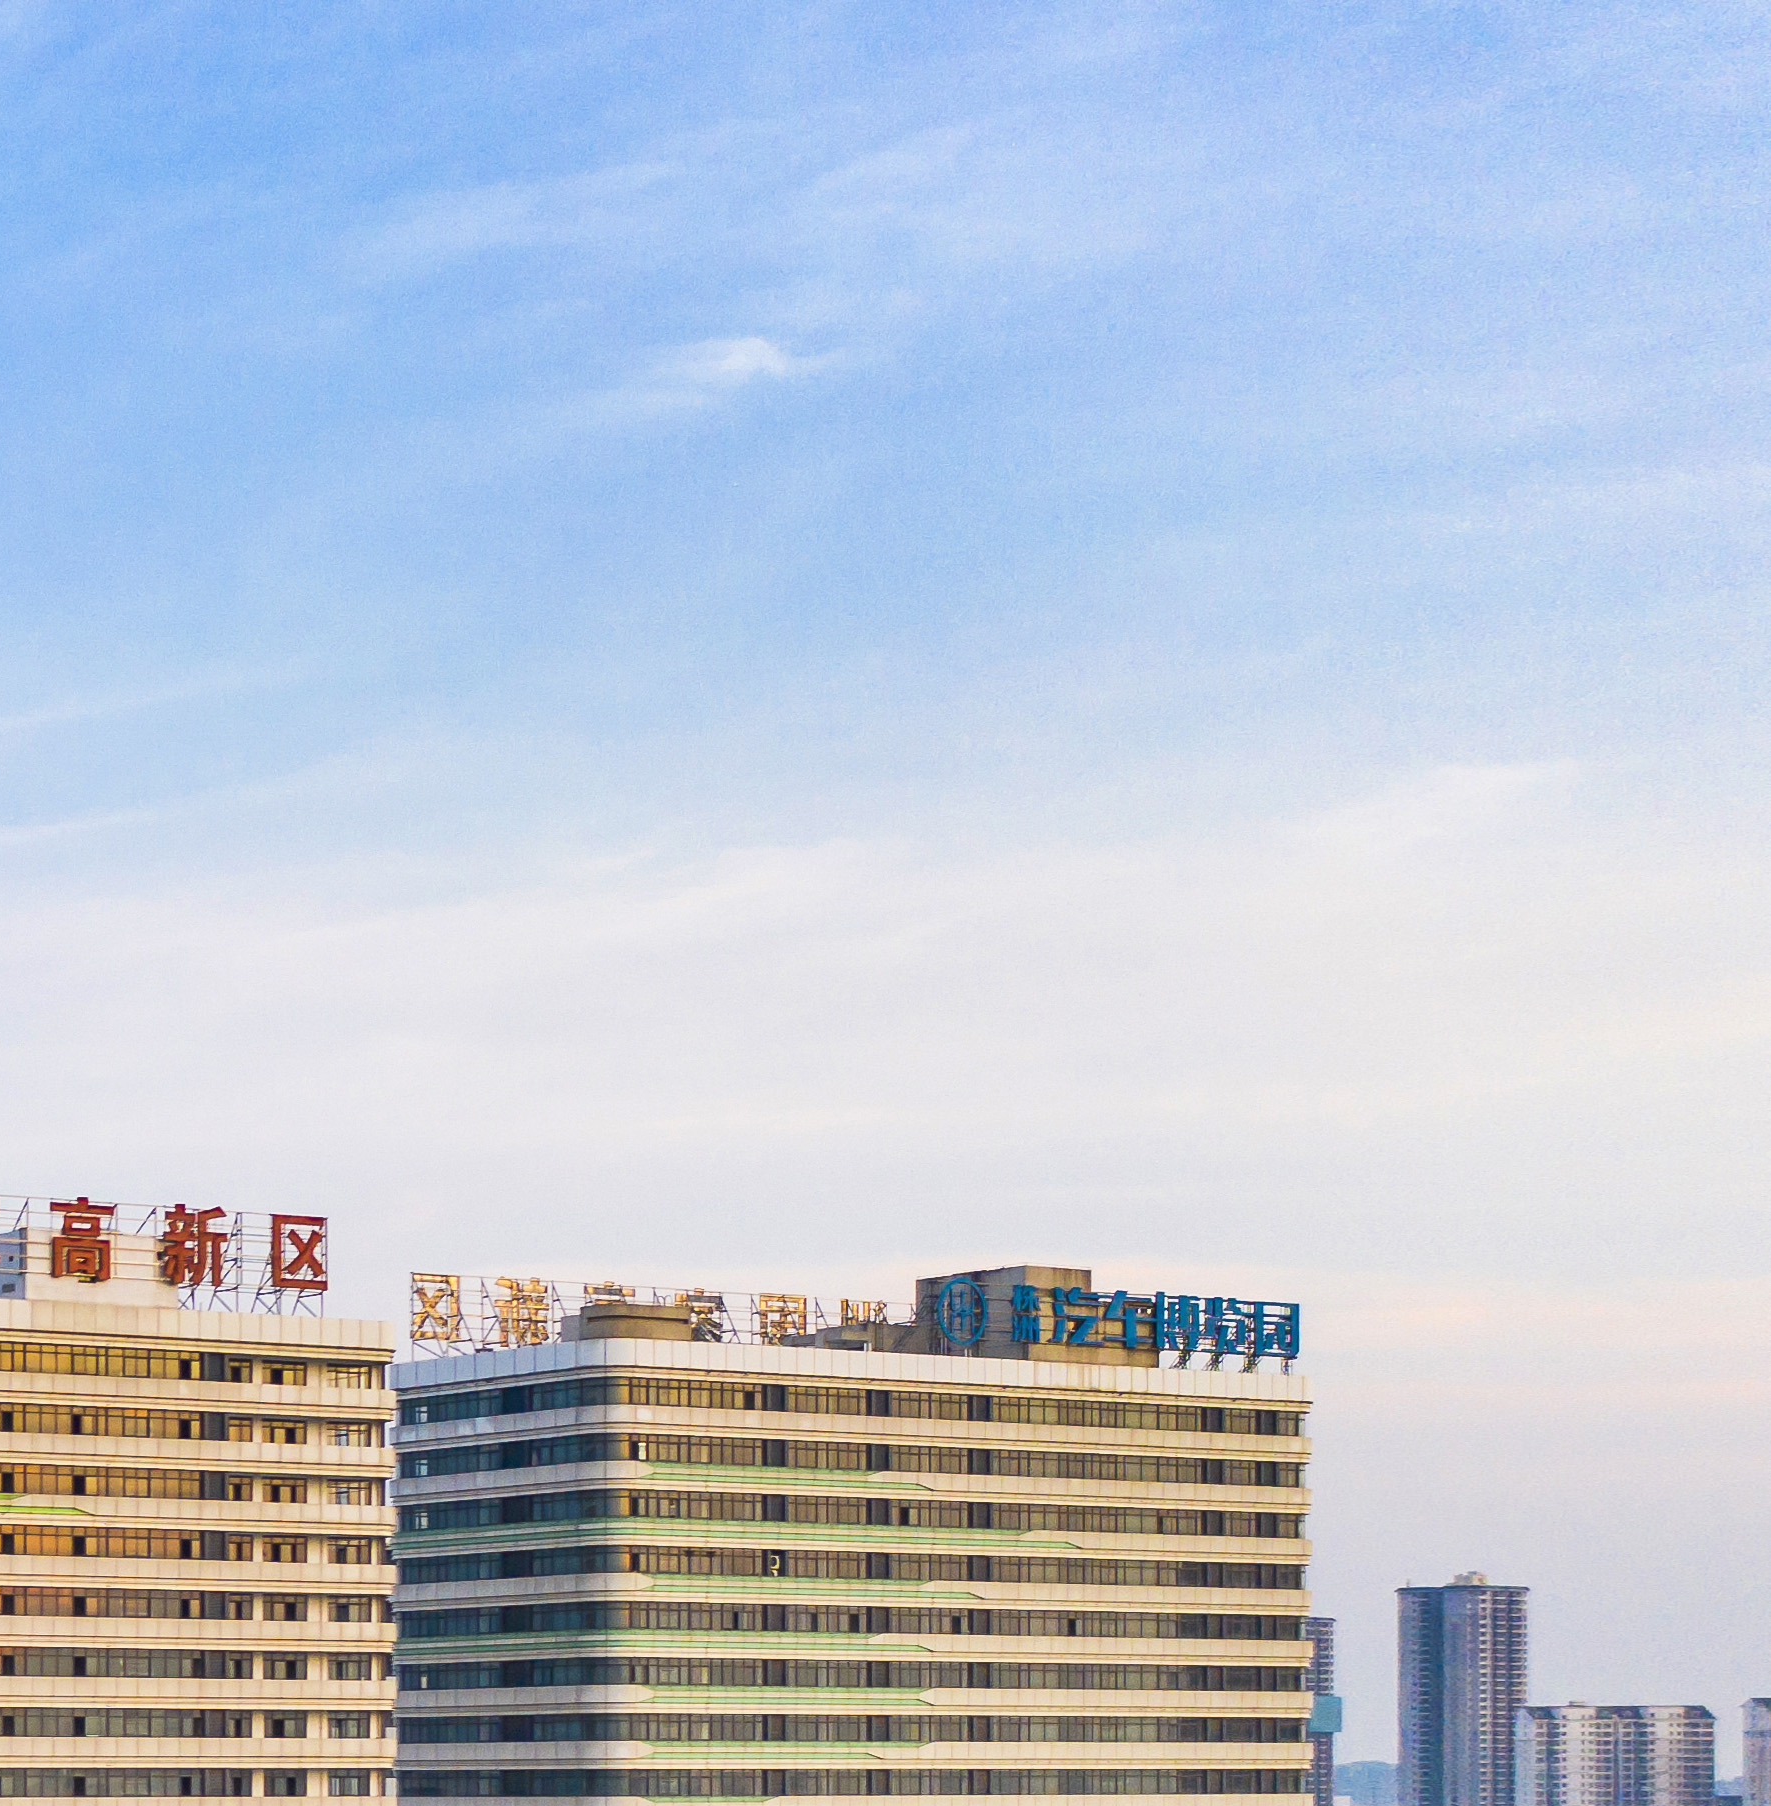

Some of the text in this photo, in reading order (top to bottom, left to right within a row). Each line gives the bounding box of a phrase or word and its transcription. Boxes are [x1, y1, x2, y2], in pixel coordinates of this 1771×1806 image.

[1011, 1284, 1300, 1357] 株洲 汽车博览园
